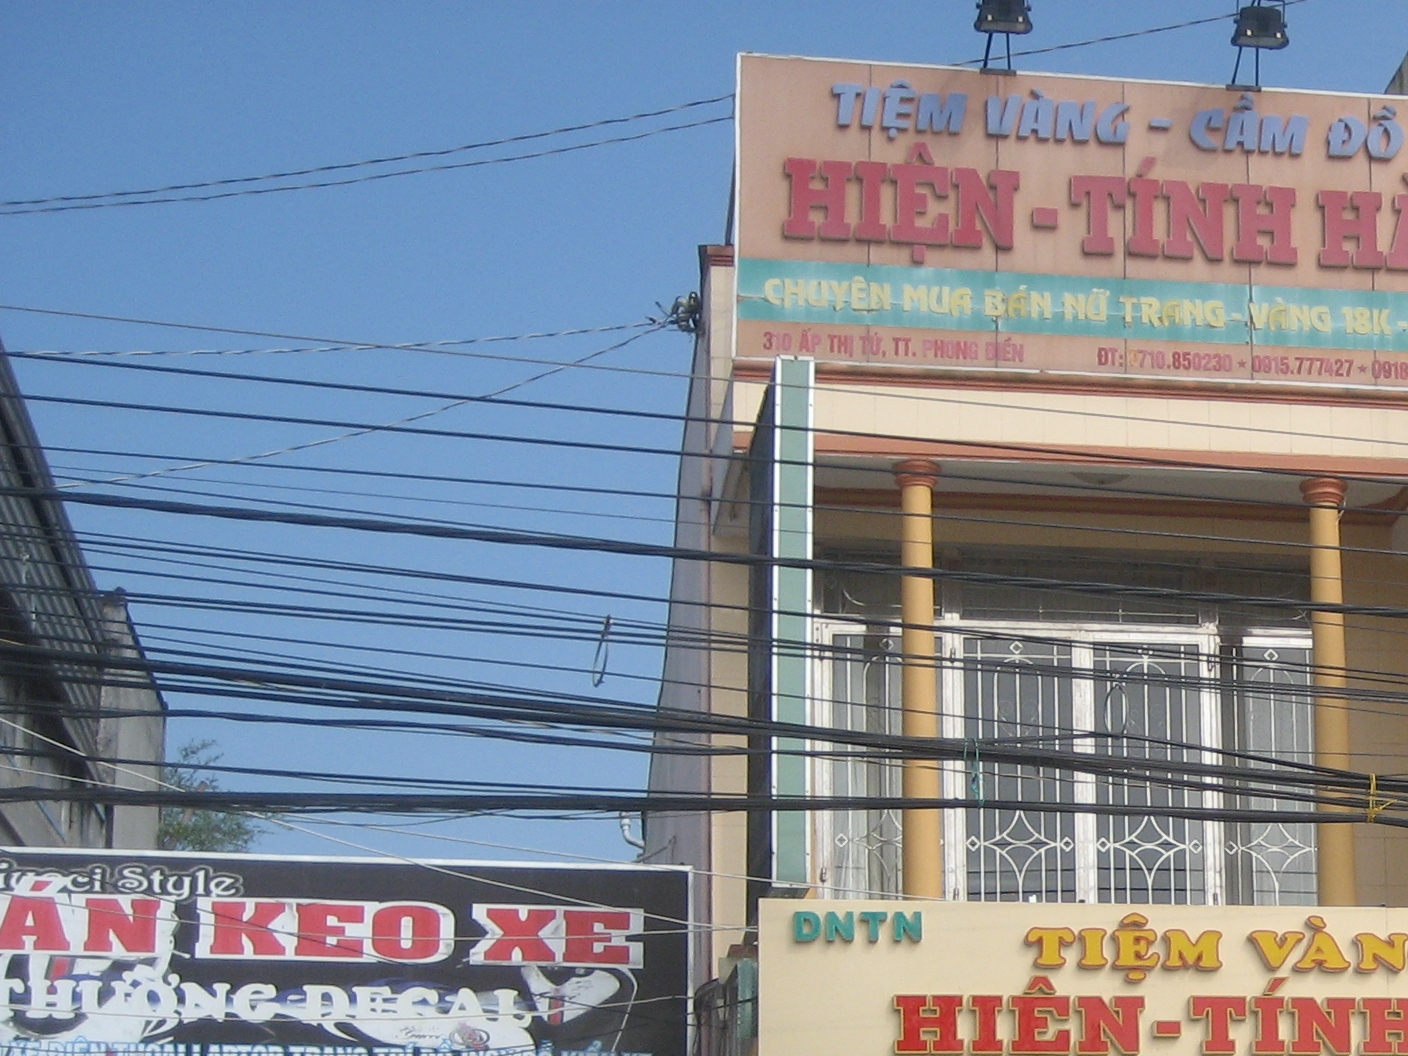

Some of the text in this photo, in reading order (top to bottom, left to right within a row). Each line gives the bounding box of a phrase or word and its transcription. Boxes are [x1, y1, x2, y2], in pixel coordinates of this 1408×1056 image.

[831, 80, 968, 139] TIỆM
[985, 86, 1131, 146] VÀNG
[1325, 104, 1406, 161] ĐỒ
[764, 276, 892, 313] CHUYÊN
[902, 284, 973, 317] MUA
[984, 284, 1052, 319] BÁN
[1341, 306, 1392, 336] 18K
[118, 867, 241, 900] Style
[209, 901, 441, 960] KEO
[484, 908, 631, 965] XE
[792, 910, 923, 943] DNTN
[1025, 912, 1223, 983] TIỆM
